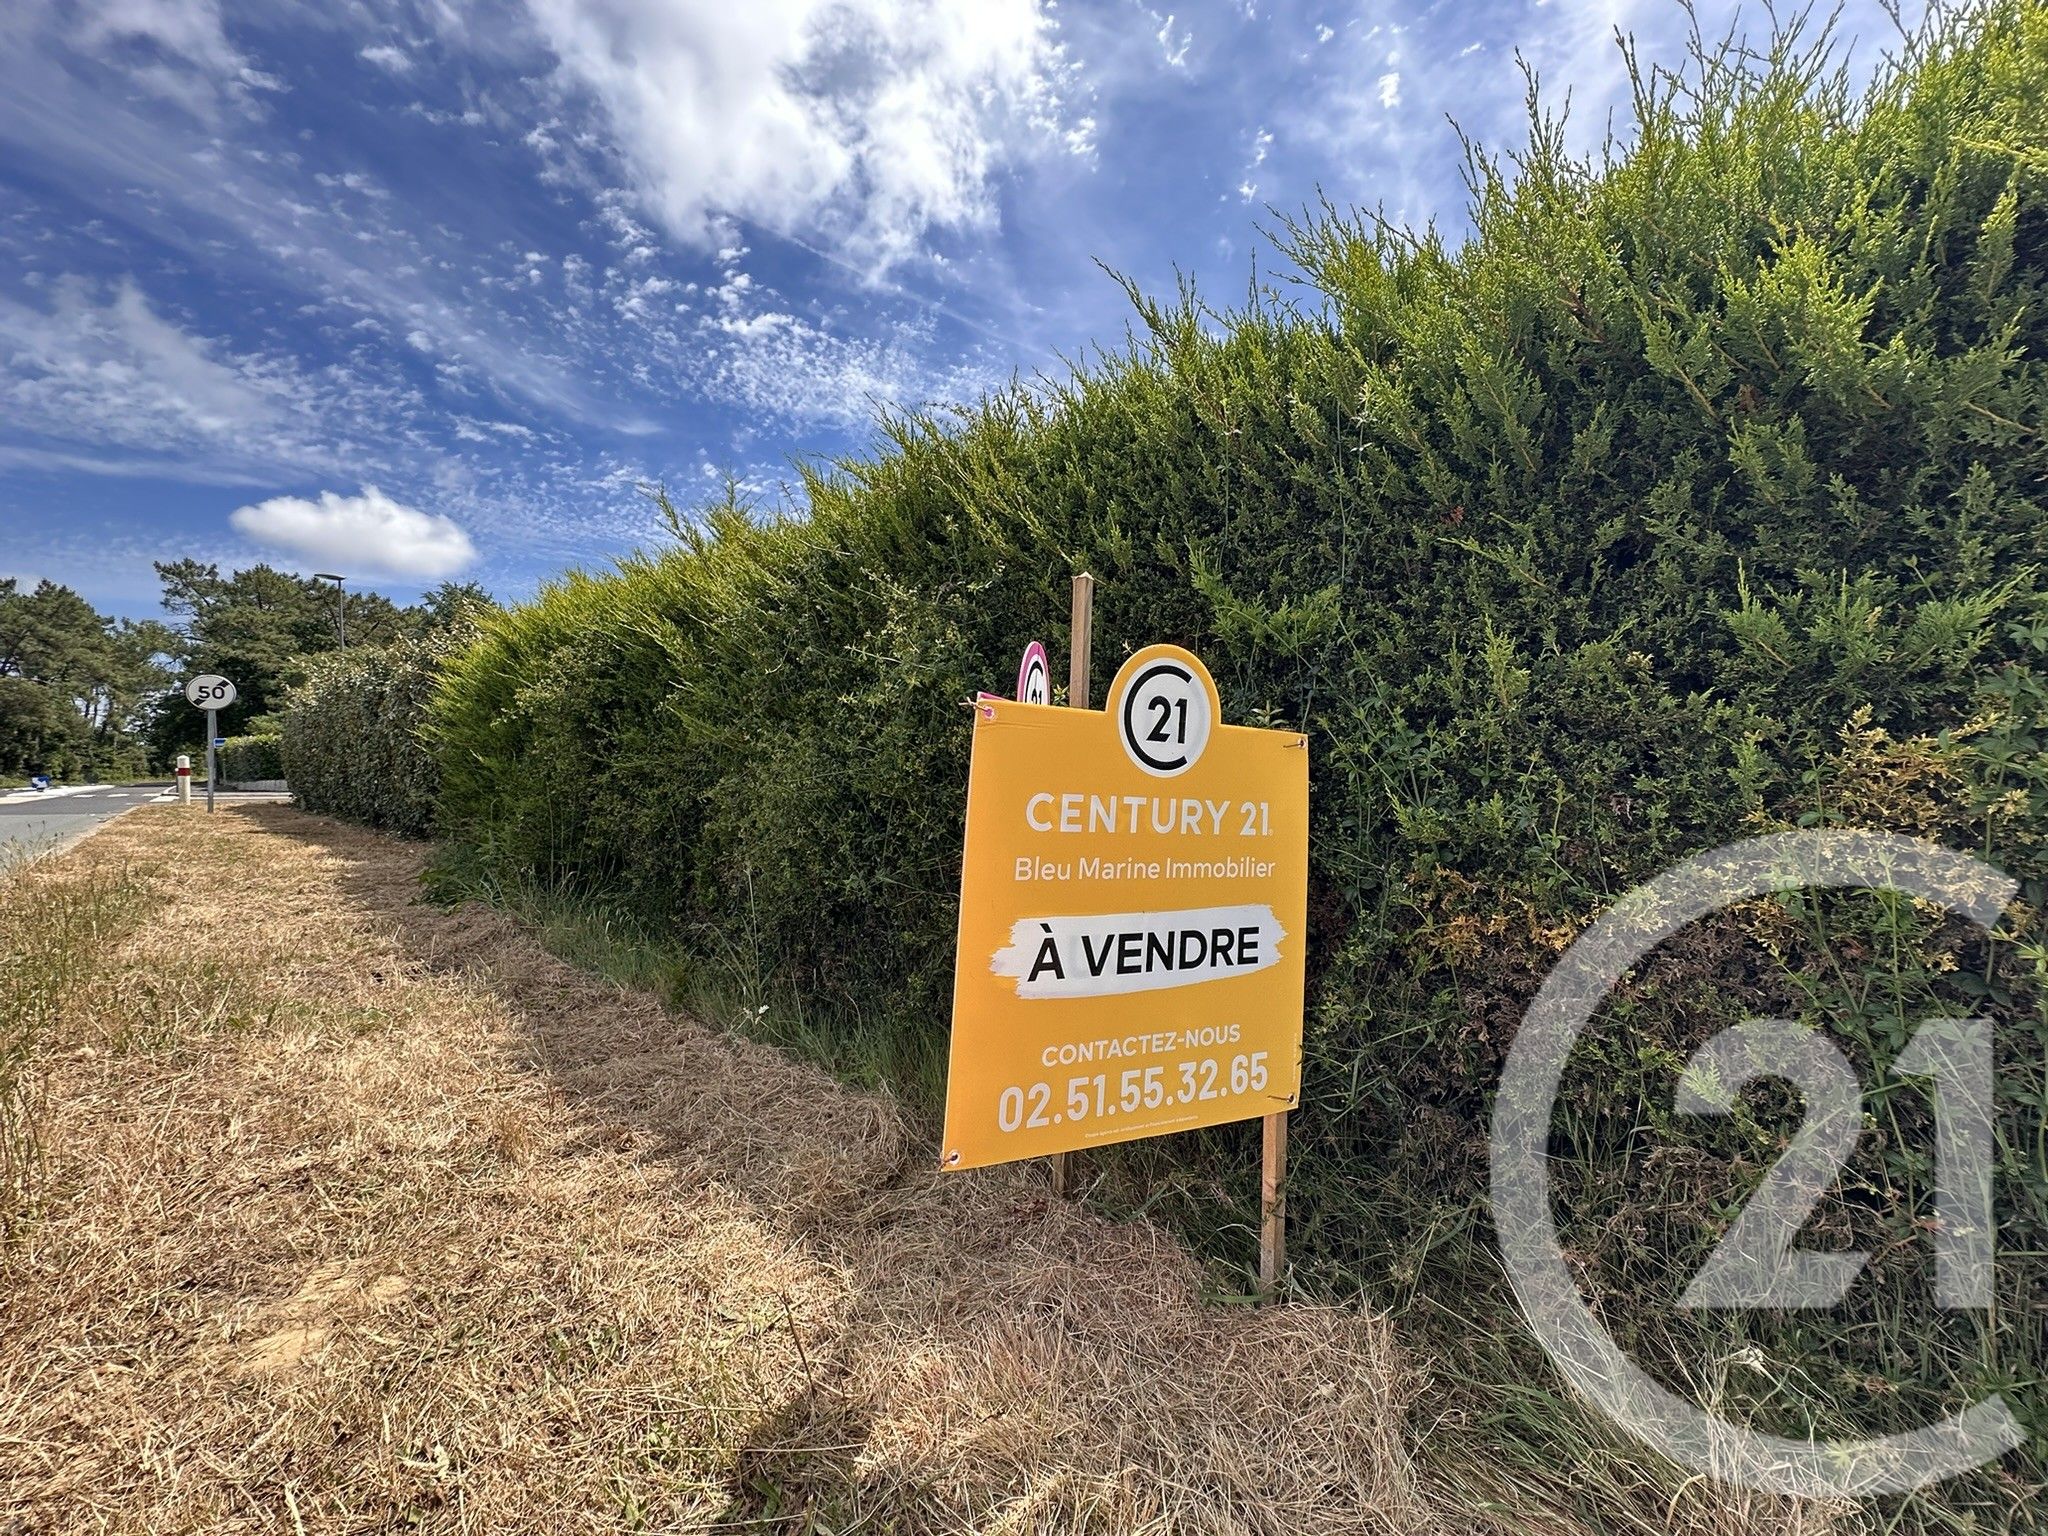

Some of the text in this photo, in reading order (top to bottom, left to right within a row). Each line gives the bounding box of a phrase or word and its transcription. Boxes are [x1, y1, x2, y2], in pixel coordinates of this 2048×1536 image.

[198, 686, 225, 700] 50
[1146, 695, 1189, 744] 21
[1025, 792, 1270, 836] CENTURY 21
[1015, 857, 1276, 881] Bleu Marine Immobilier
[1027, 923, 1260, 982] À VENDRE
[1041, 1024, 1241, 1068] CONTACTEZ-NOUS
[998, 1051, 1269, 1132] 02.51.55.32.65
